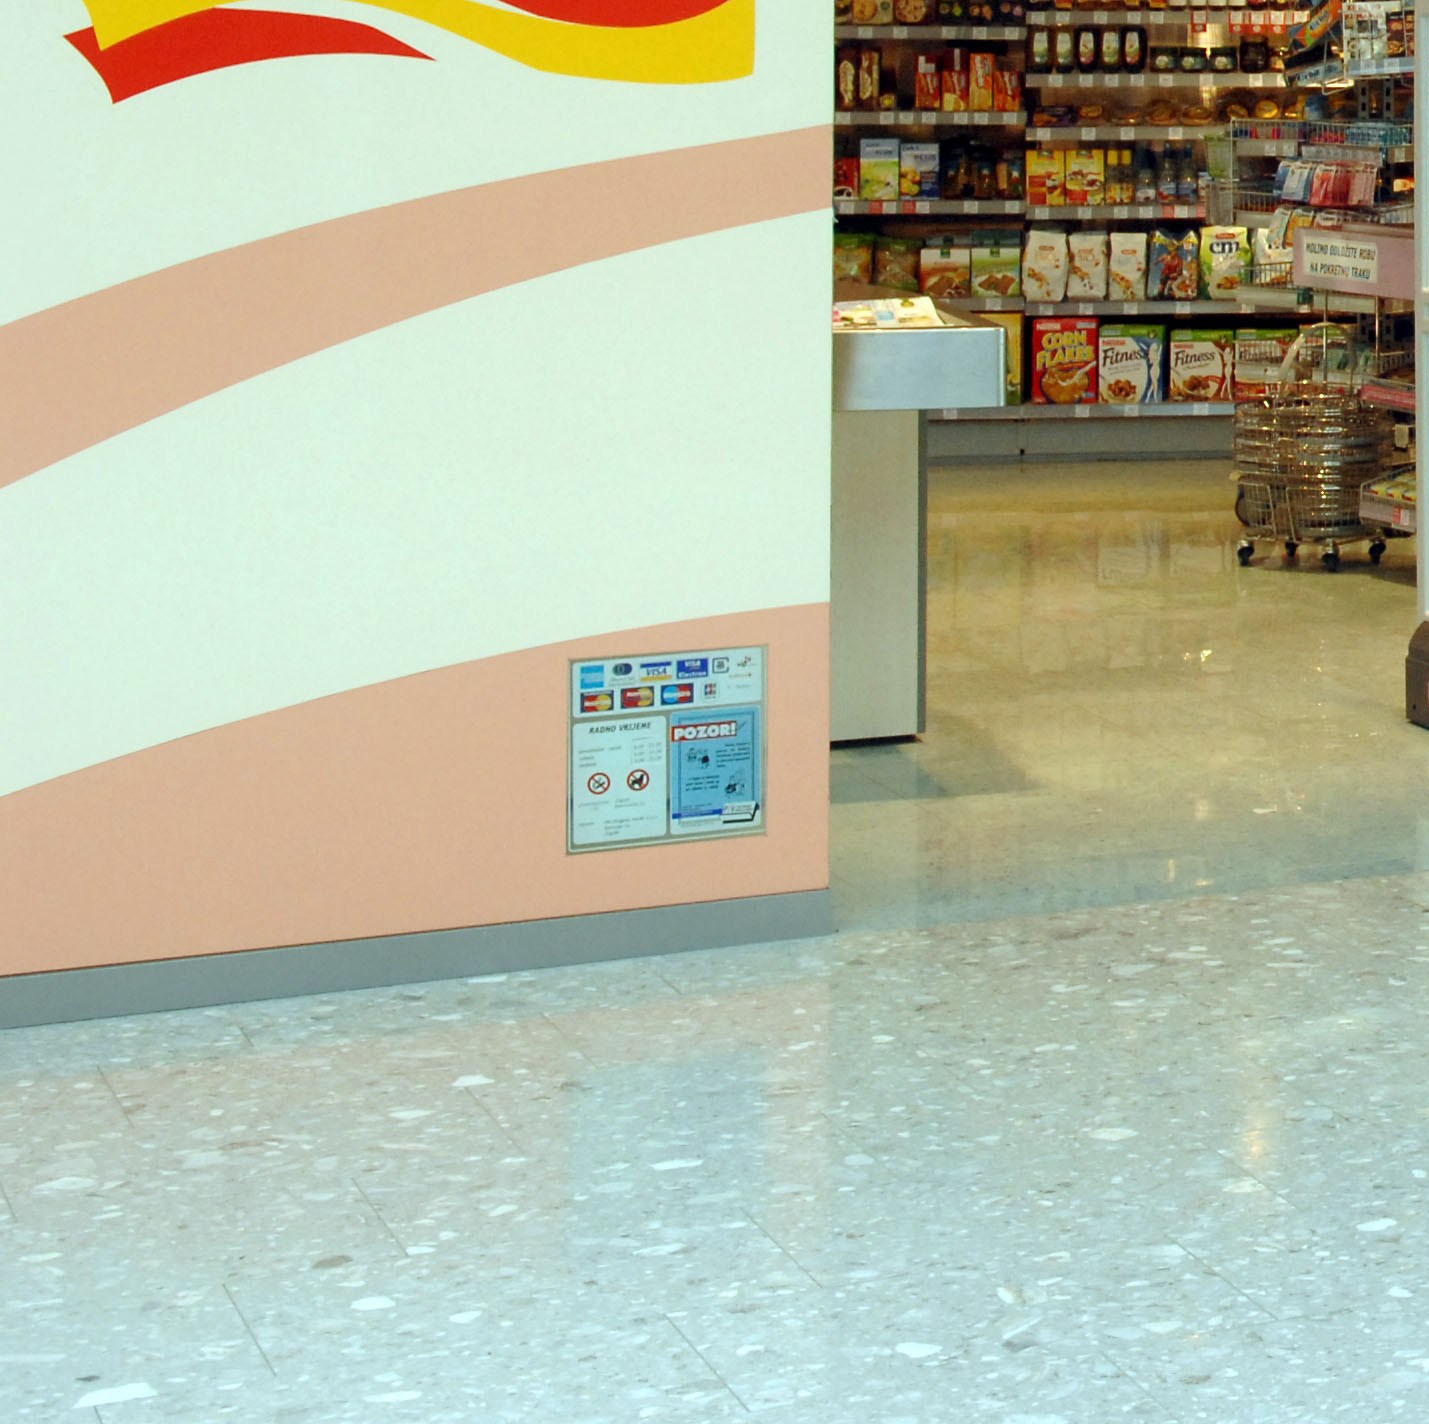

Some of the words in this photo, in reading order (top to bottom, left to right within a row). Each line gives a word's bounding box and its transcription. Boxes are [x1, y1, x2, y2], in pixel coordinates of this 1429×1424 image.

[1041, 330, 1087, 351] CORN
[1036, 344, 1095, 372] FLAKES
[1174, 348, 1216, 367] Fitness
[674, 723, 736, 741] POZOR!
